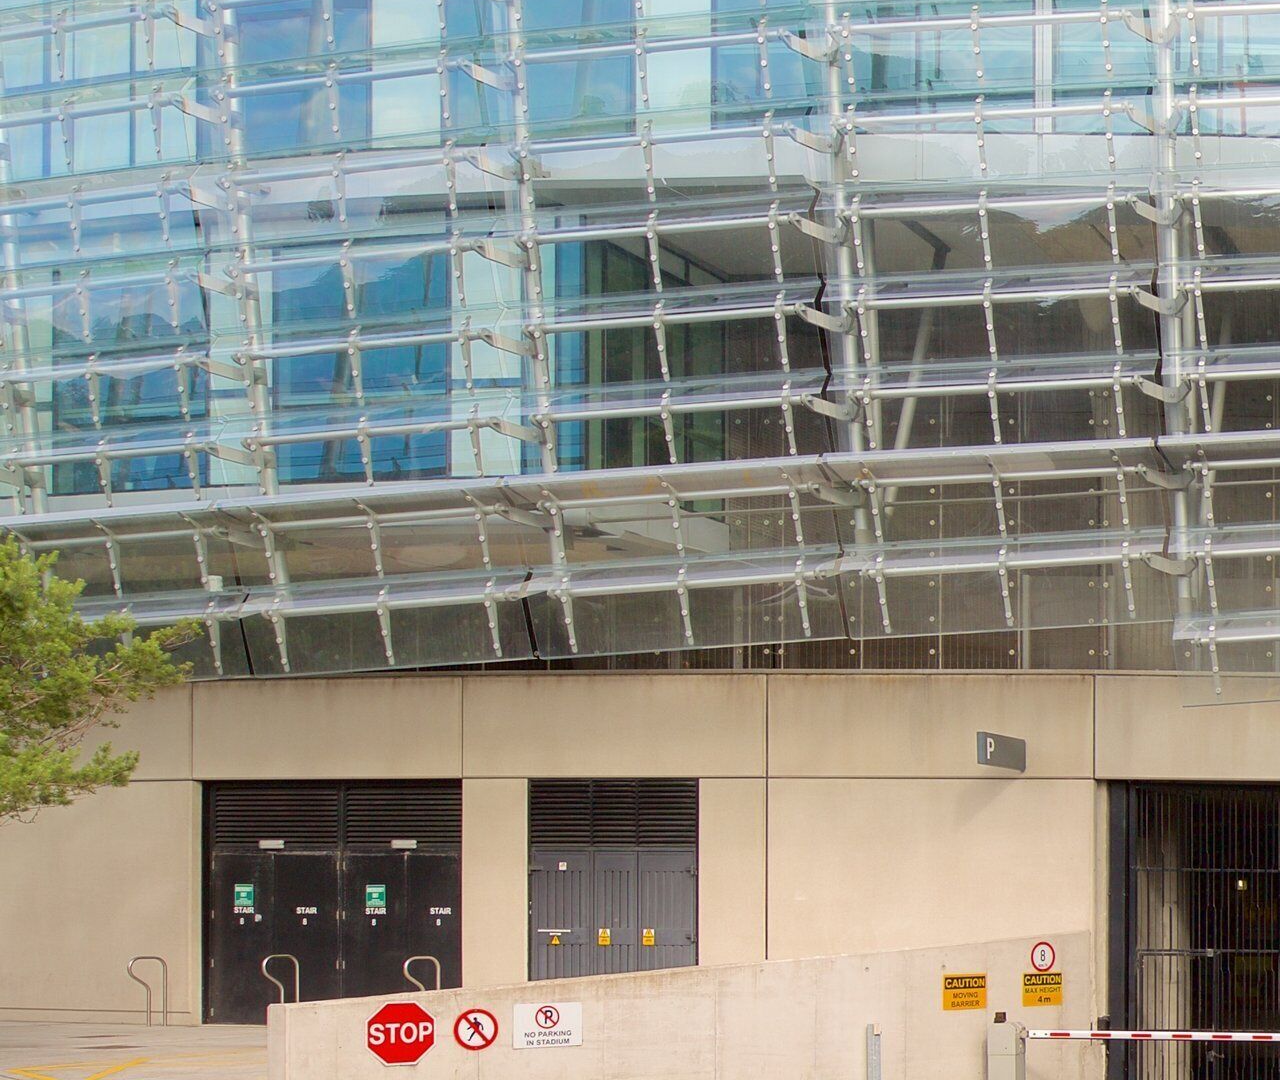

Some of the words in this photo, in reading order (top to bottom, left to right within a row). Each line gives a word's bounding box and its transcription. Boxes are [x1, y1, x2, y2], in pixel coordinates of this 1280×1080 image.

[987, 738, 995, 759] P
[234, 906, 254, 914] STAIR
[296, 906, 317, 914] STAIR
[365, 907, 386, 915] STAIR
[430, 907, 451, 915] STAIR
[1040, 949, 1046, 961] 8
[945, 977, 985, 989] CAUTION
[1024, 975, 1061, 985] CAUTION
[369, 1021, 433, 1045] STOP
[538, 1030, 572, 1038] PARKING
[536, 1038, 570, 1046] STADIUM
